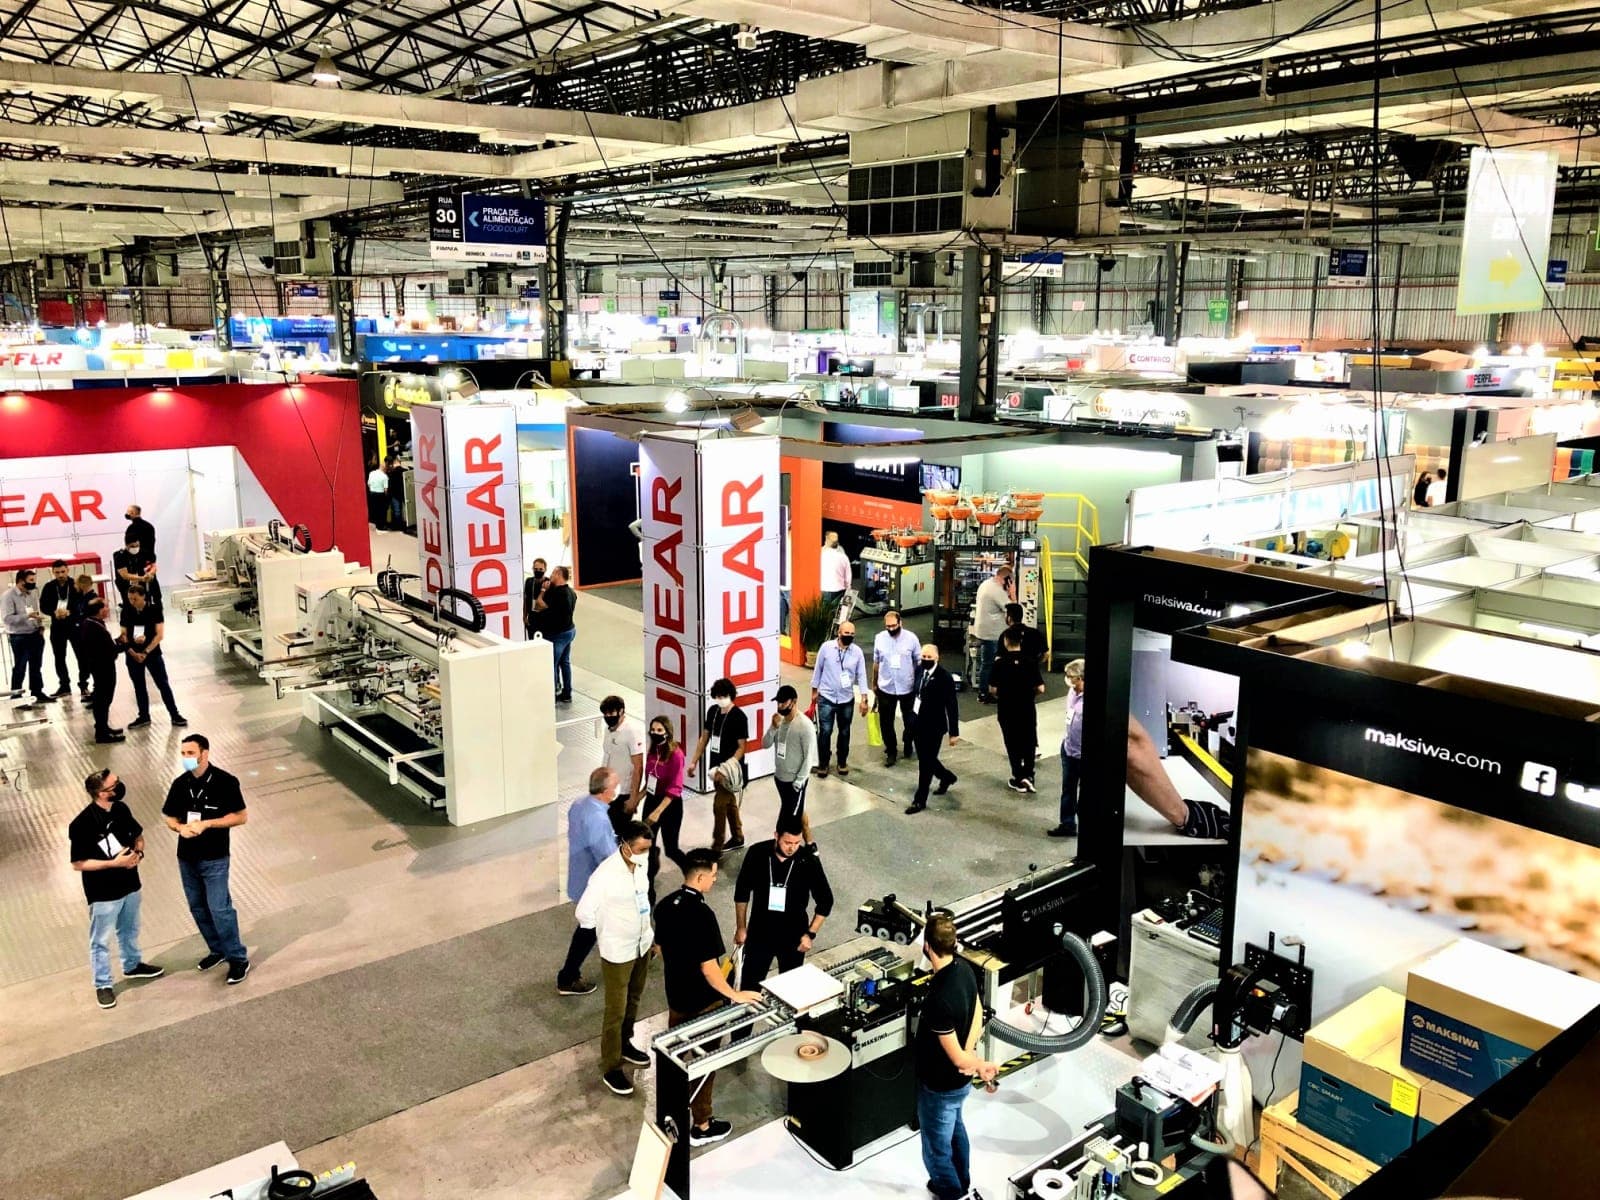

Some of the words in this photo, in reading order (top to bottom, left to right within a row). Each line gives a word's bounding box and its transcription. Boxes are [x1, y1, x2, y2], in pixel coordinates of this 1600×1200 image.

[437, 196, 453, 204] RUA
[435, 208, 457, 224] 30
[508, 208, 520, 217] DE
[482, 215, 535, 225] ALIMENTAÇÃO
[452, 228, 461, 239] E
[1143, 593, 1222, 618] maksiwa.com
[1364, 727, 1502, 775] maksiwa.com
[1425, 1021, 1480, 1051] MAKSIWA
